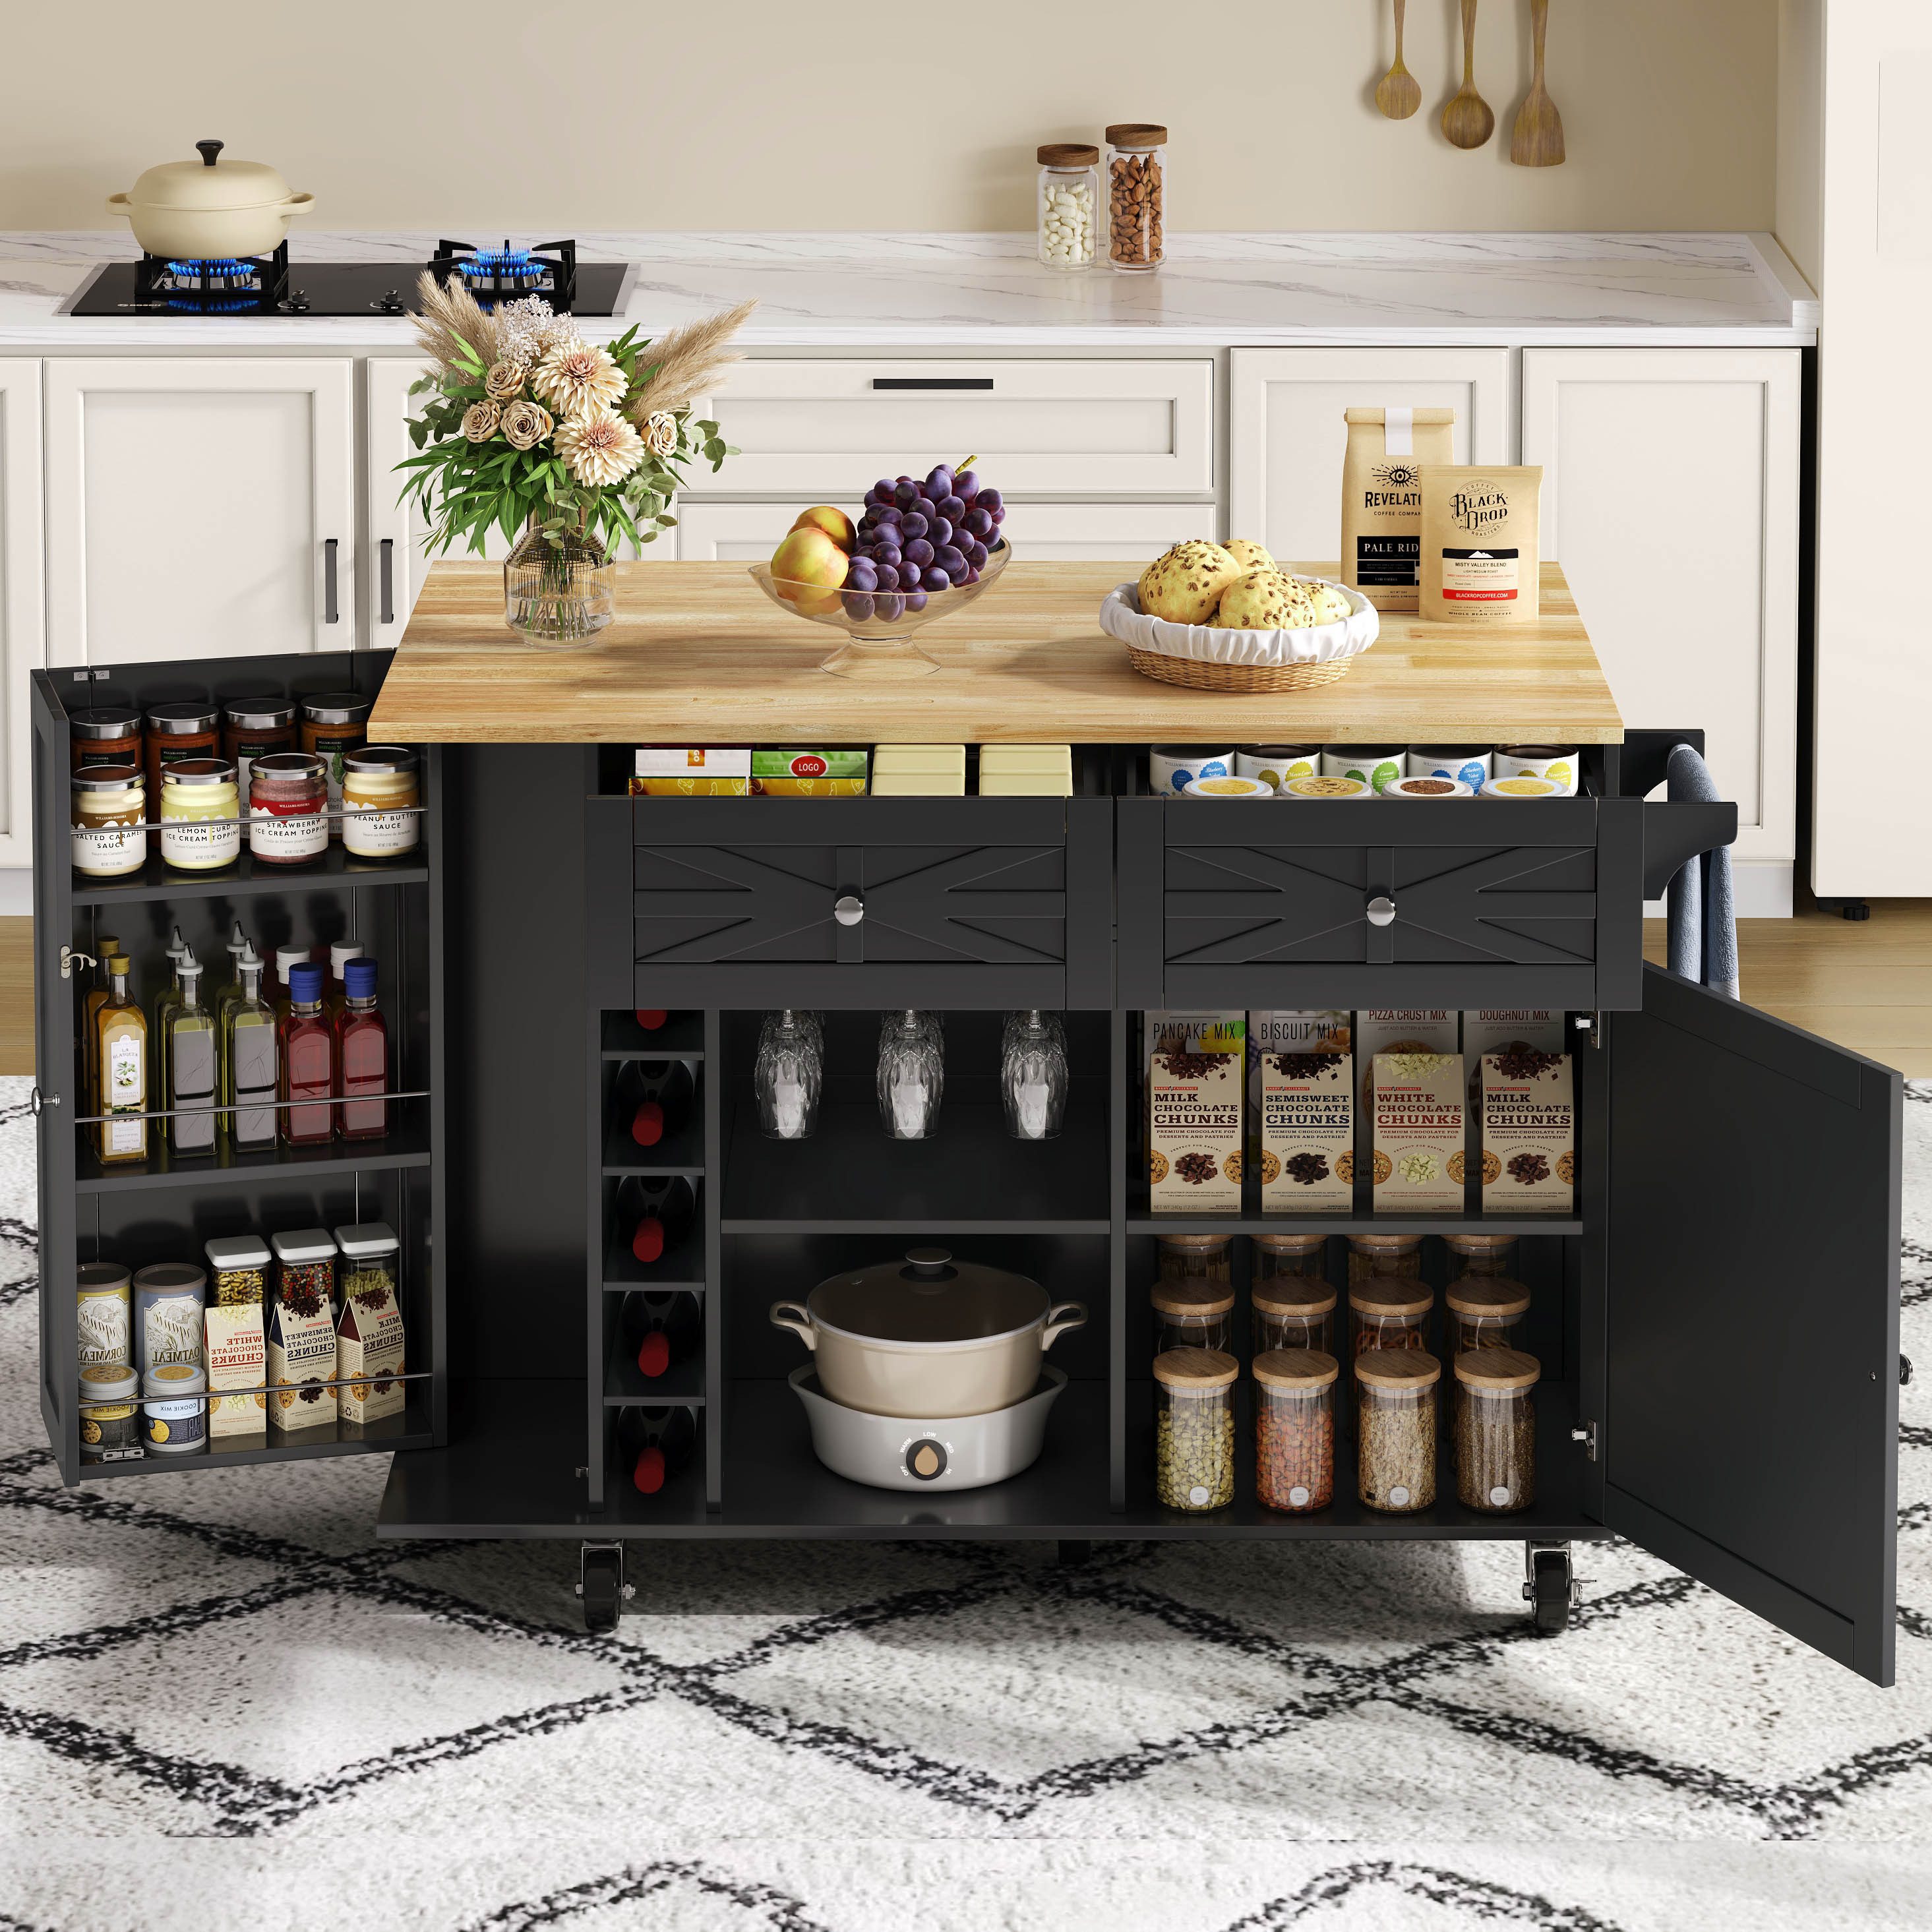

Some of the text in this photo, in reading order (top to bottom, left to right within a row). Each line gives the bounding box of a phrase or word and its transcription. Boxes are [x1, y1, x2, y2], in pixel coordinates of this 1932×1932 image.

[1449, 493, 1509, 518] BLACK
[1460, 508, 1508, 530] DROP
[1471, 525, 1500, 536] ROASTERS
[1364, 543, 1418, 552] PALE RID
[212, 824, 231, 833] CURD
[267, 819, 320, 828] STRAWBERRY
[212, 828, 239, 841] TOPPING
[1369, 1010, 1447, 1021] PIZZA CRUST MIX
[1480, 1010, 1550, 1021] DOUGHNUT MIX
[1154, 1023, 1236, 1040] PANCAKE MIX
[1261, 1023, 1339, 1040] BISCUIT MIX
[1154, 1093, 1198, 1102] MILK
[1377, 1094, 1435, 1102] WHITE
[1487, 1094, 1531, 1102] MILK
[1154, 1114, 1238, 1124] CHUNKS
[1266, 1114, 1350, 1124] CHUNKS
[1377, 1114, 1461, 1124] CHUNKS
[1487, 1115, 1571, 1124] CHUNKS
[899, 1437, 913, 1453] WARM
[945, 1441, 954, 1454] MED
[900, 1465, 909, 1476] OFF
